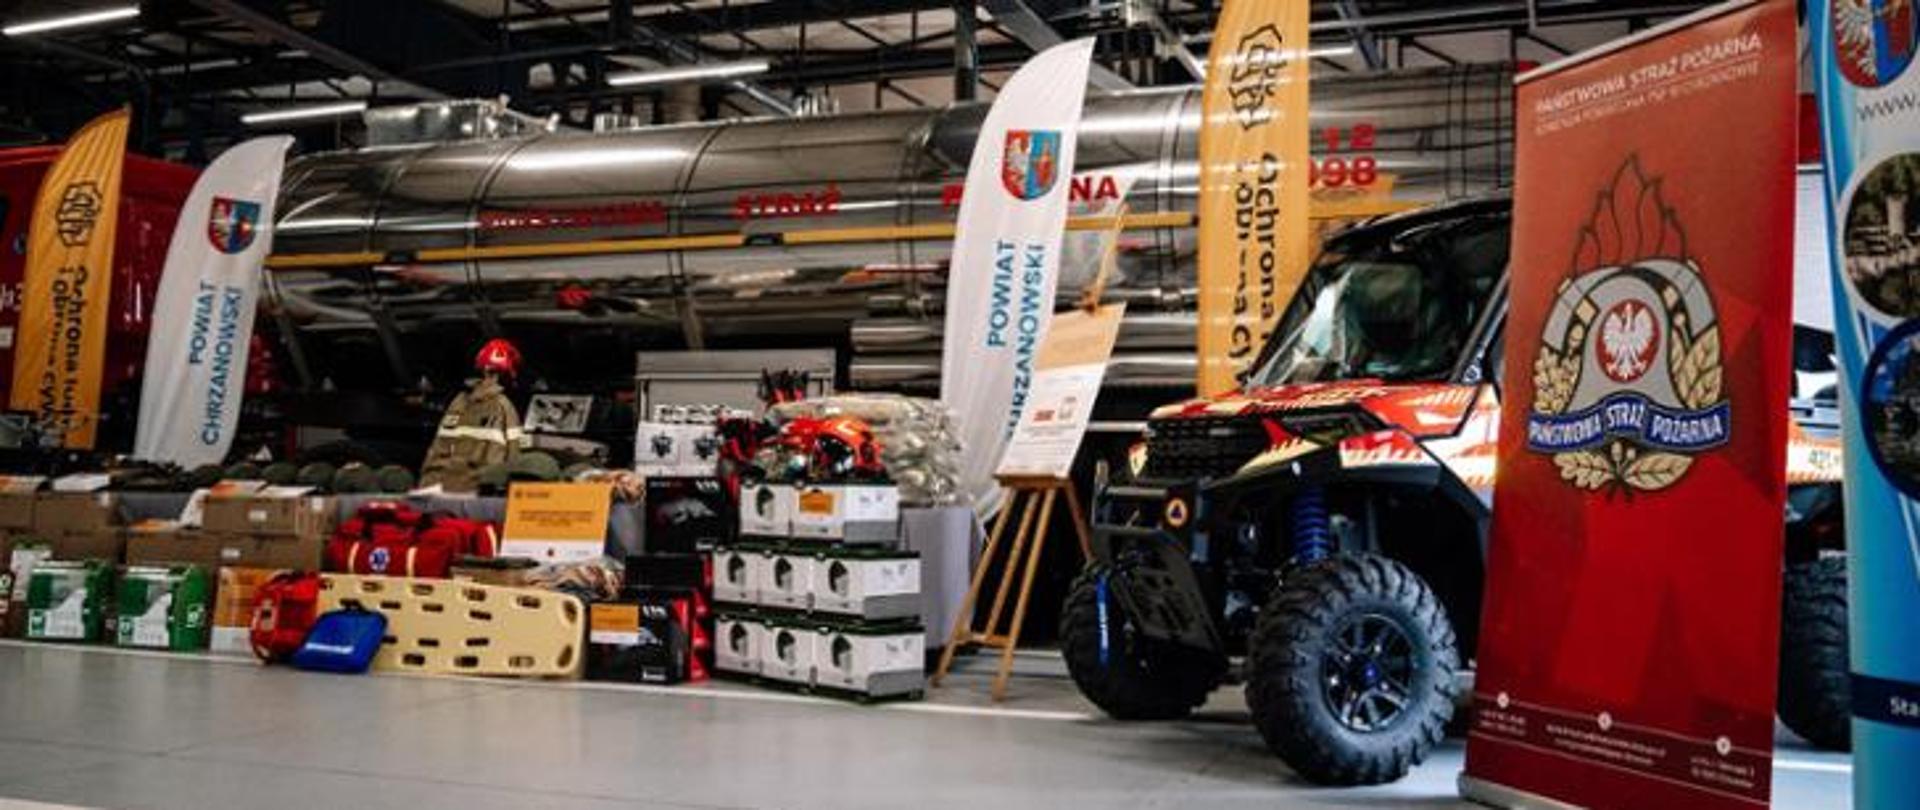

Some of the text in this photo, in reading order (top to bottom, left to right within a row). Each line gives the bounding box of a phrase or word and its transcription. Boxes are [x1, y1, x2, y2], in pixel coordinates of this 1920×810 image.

[189, 280, 216, 366] POWIAT
[987, 240, 1016, 348] POWIAT
[1003, 245, 1045, 442] HRZANOWSKI
[202, 287, 242, 446] CHRZANOWSKI
